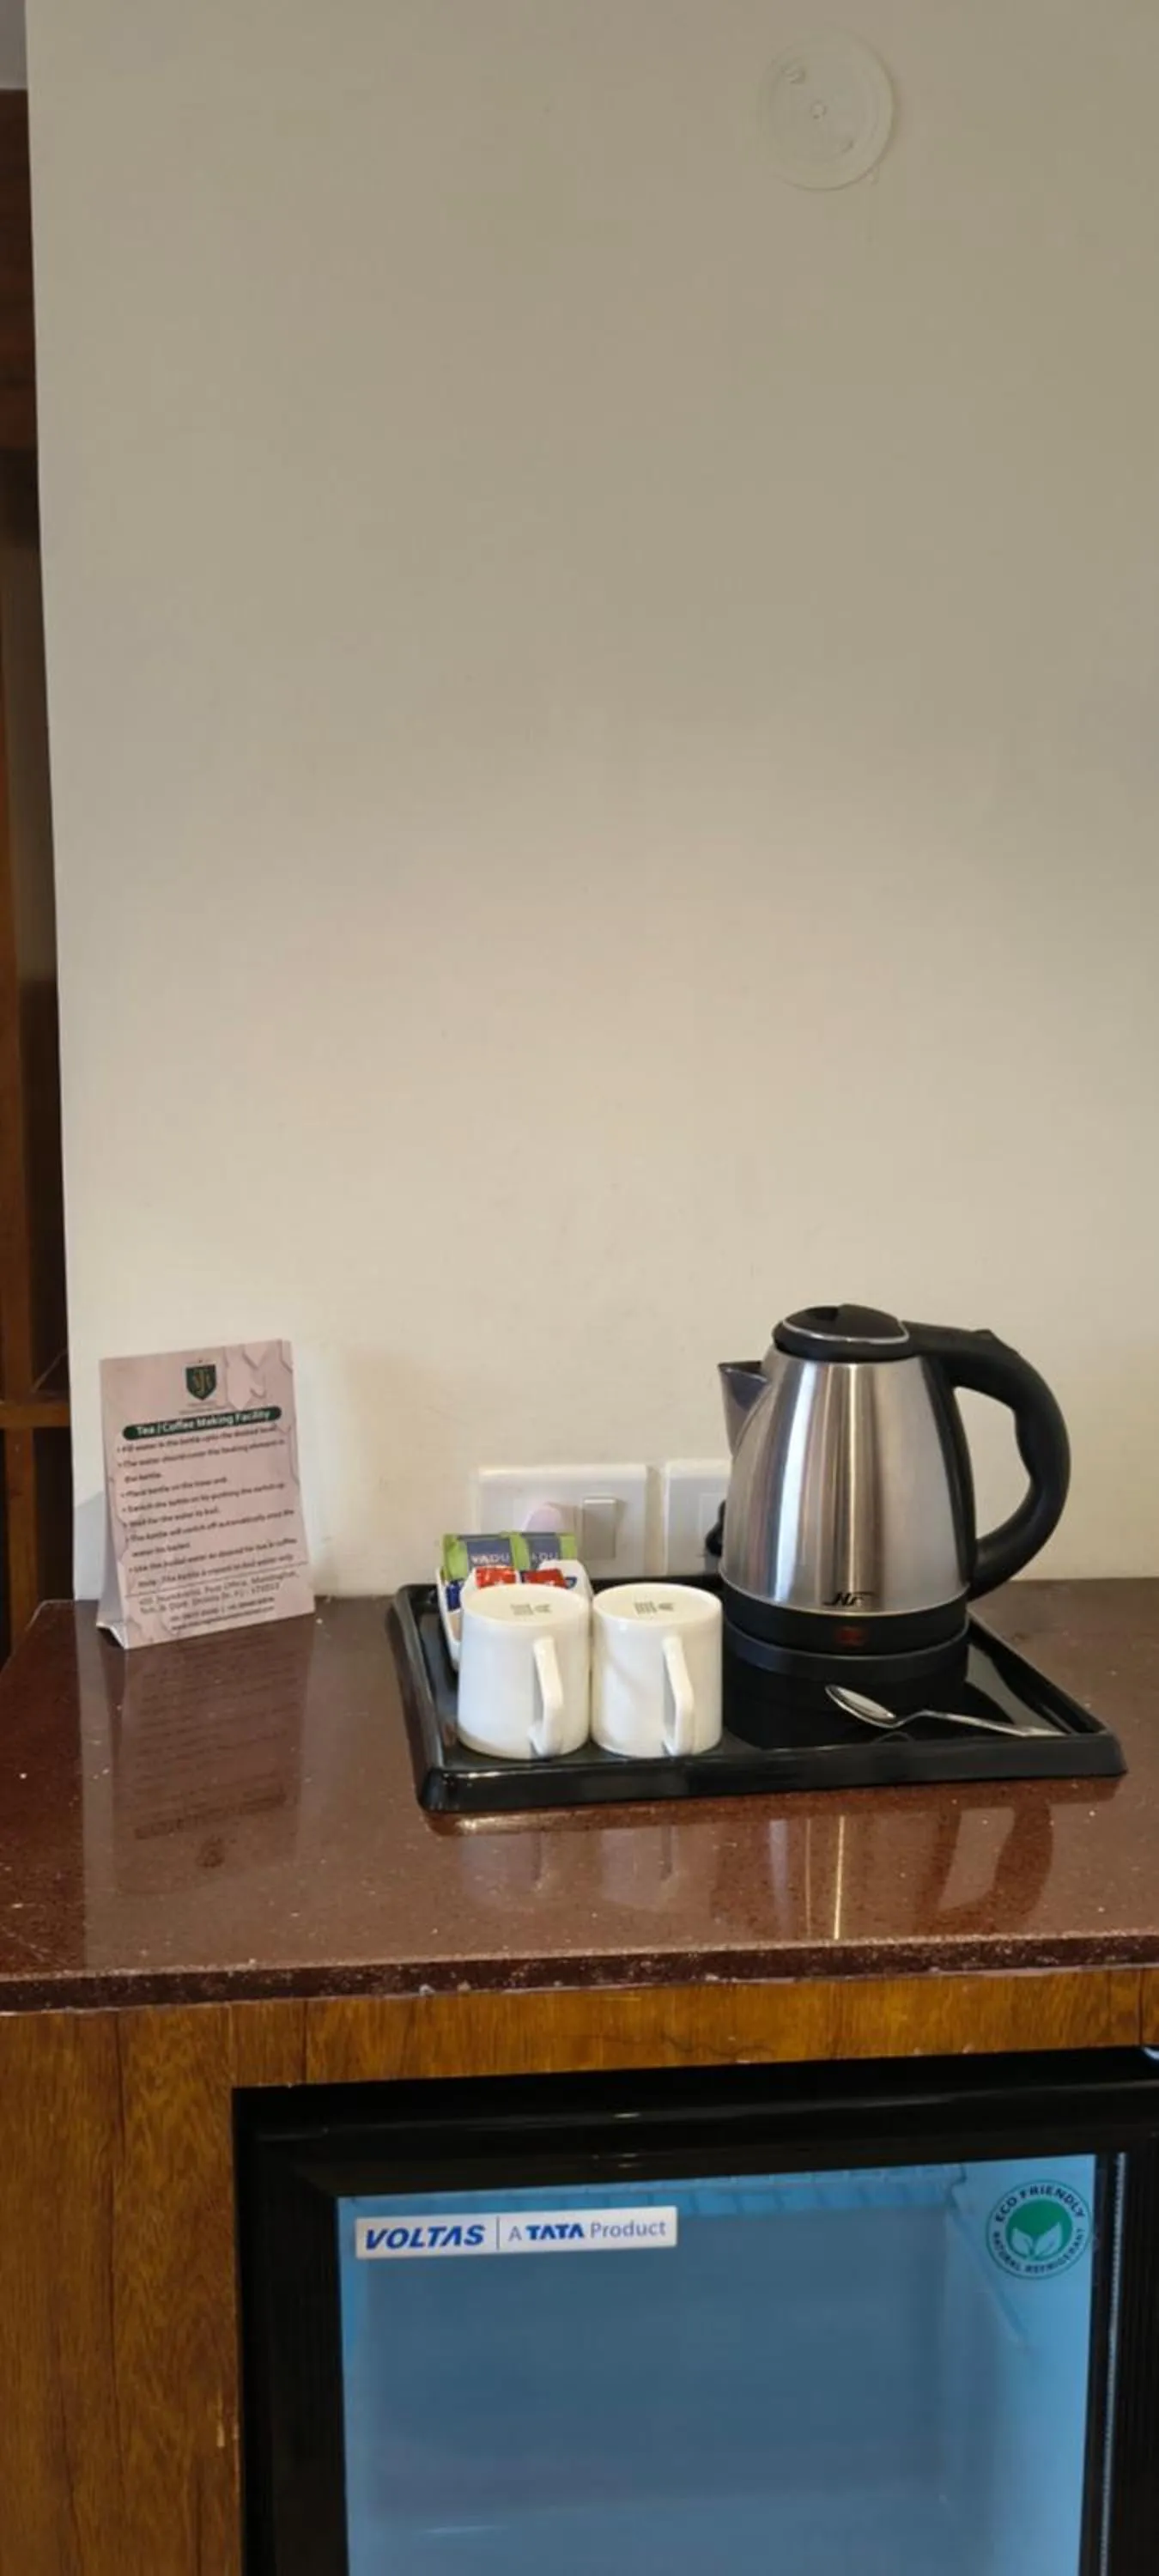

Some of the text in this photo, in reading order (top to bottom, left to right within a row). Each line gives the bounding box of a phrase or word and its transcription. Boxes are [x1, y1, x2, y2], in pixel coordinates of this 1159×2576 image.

[162, 1421, 195, 1432] Coffee
[197, 1415, 234, 1428] Making
[234, 1410, 271, 1423] Facility
[995, 2184, 1085, 2223] ECO FRIENDLY
[365, 2220, 666, 2250] VOLTAS A TATA Product
